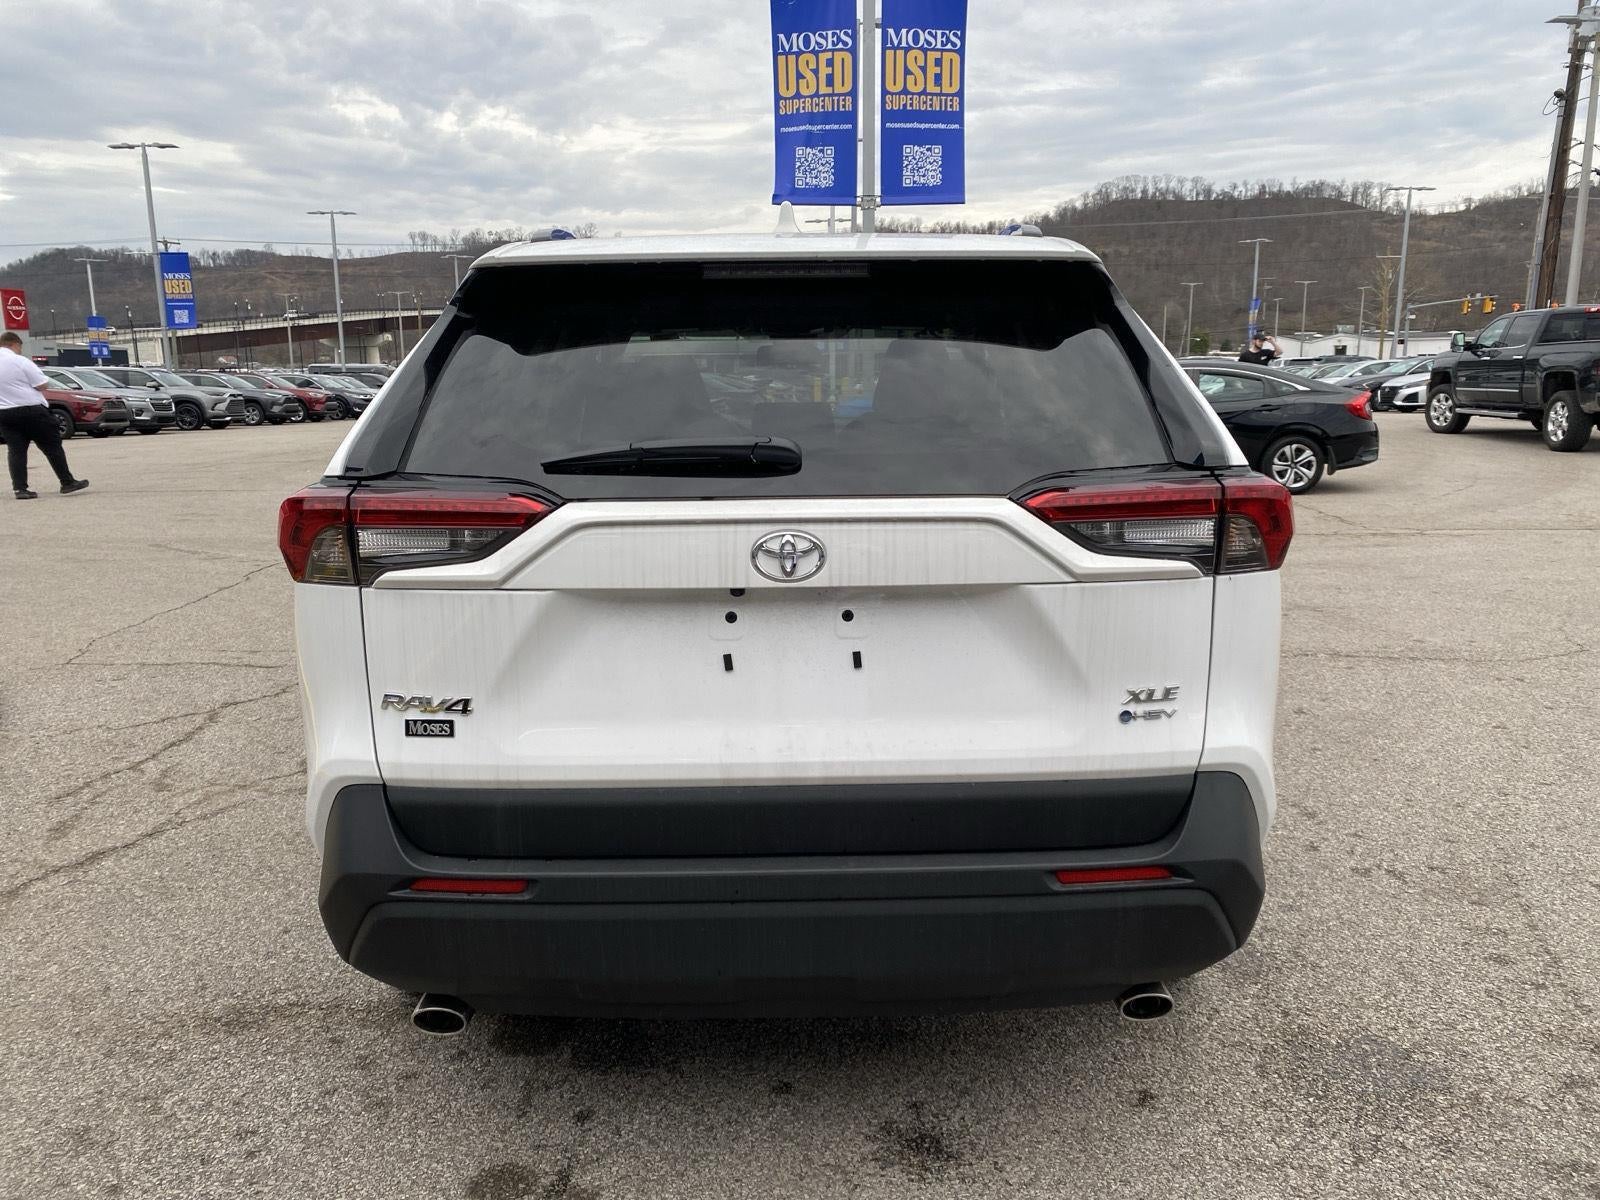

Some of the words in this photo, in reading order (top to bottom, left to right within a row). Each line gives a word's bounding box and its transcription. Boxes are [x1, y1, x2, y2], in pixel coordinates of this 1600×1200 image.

[777, 29, 852, 53] MOSES
[886, 28, 961, 50] MOSES
[777, 52, 853, 98] USED
[885, 49, 961, 94] USED
[779, 96, 853, 115] SUPERCENTER
[885, 95, 960, 111] SUPERCENTER
[780, 123, 853, 134] mosesusedsupercenter.com
[885, 122, 960, 131] mosesusedsupercenter.com
[164, 280, 193, 294] USED
[381, 692, 473, 715] RAV4
[1121, 685, 1180, 705] XLE
